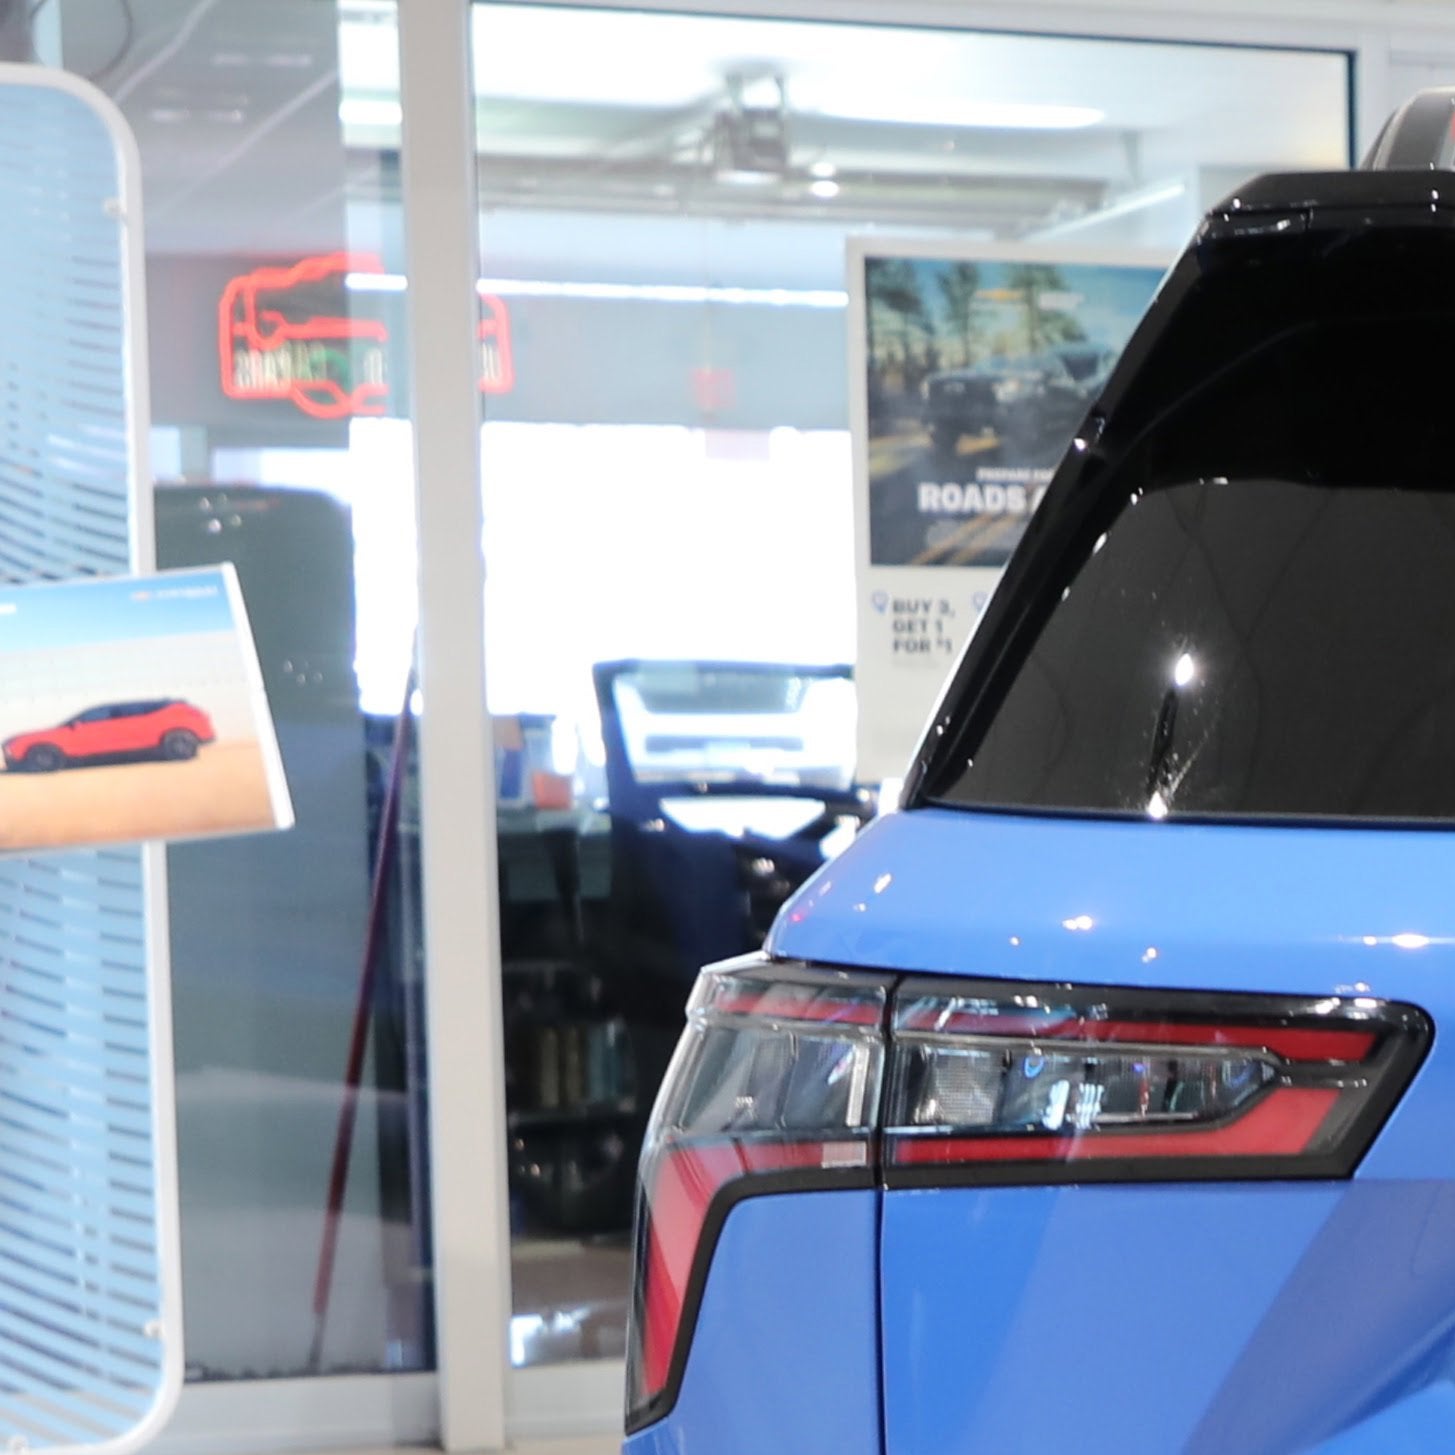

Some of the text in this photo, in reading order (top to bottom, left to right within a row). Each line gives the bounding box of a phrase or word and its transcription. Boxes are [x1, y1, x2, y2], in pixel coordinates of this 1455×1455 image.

[918, 482, 1026, 513] ROADS
[893, 599, 932, 614] BUY
[893, 619, 927, 633] GET
[893, 639, 930, 653] FOR
